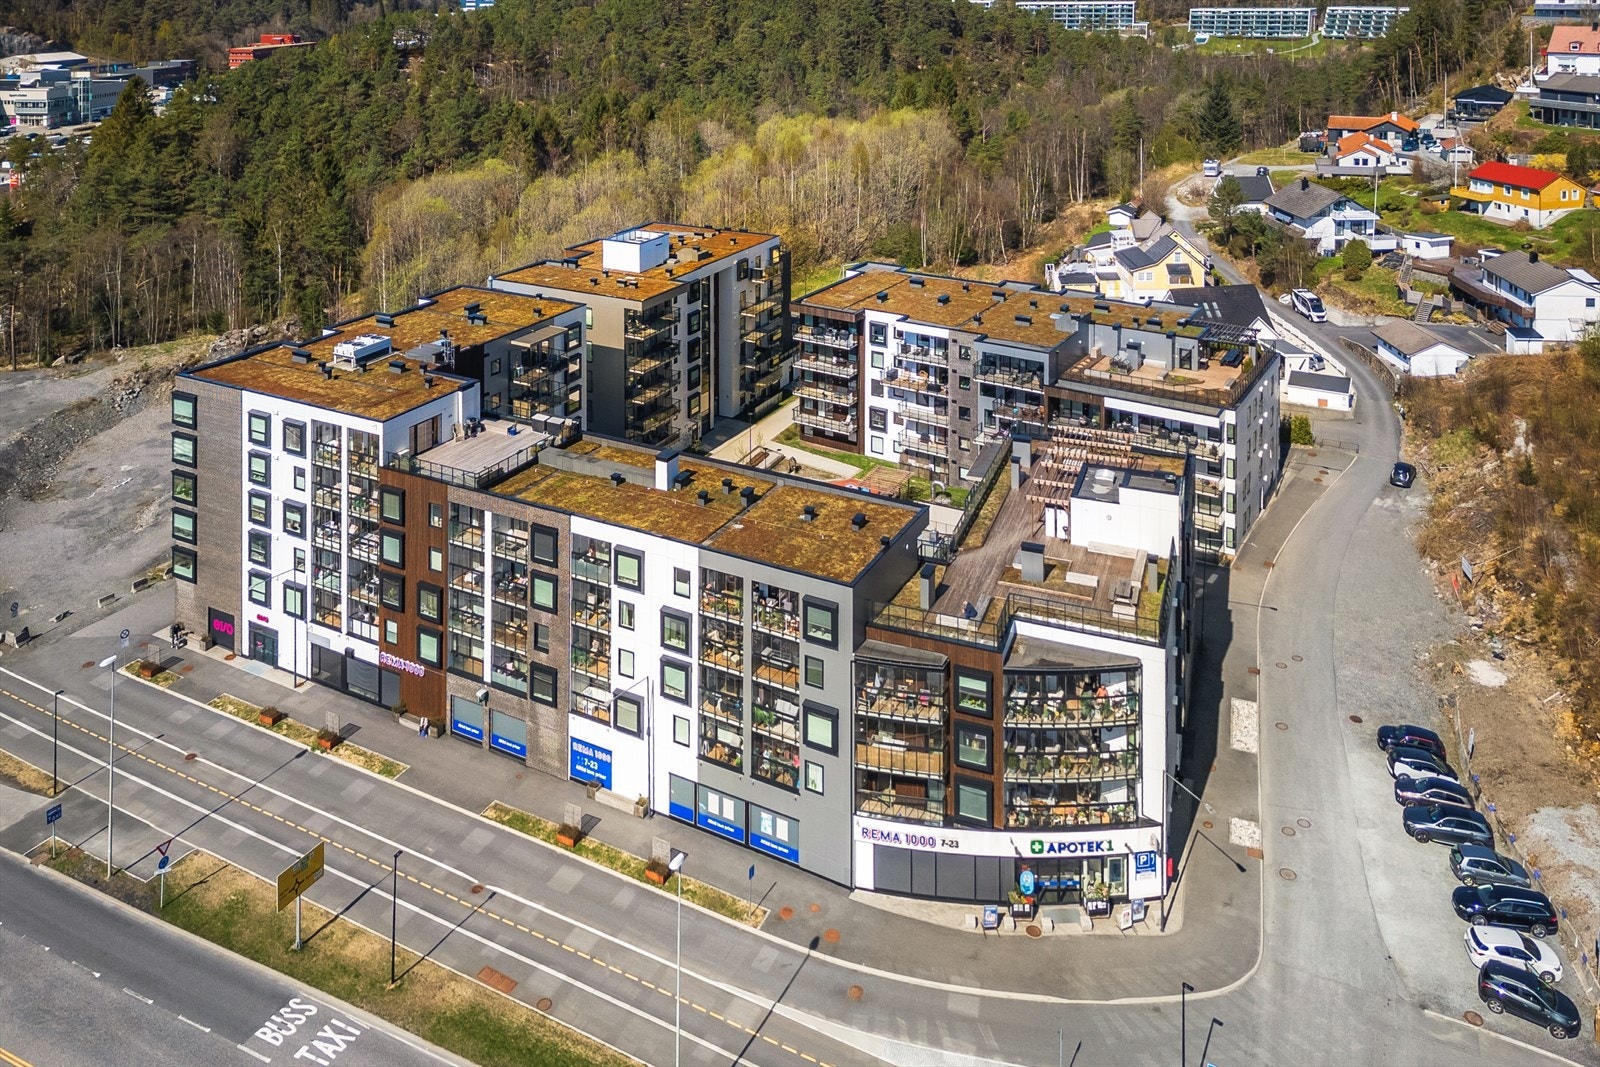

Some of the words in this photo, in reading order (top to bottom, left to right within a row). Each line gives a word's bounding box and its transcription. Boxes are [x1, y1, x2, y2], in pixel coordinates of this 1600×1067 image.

[213, 619, 234, 635] evo
[380, 651, 404, 670] REMA
[404, 660, 425, 677] 1000
[572, 742, 594, 757] REMA
[594, 749, 611, 763] 1000
[584, 758, 598, 770] 7-23
[862, 827, 901, 844] REMA
[905, 834, 936, 848] 1000
[940, 839, 959, 848] 7-23
[1139, 855, 1147, 865] P
[254, 998, 318, 1047] BUSS
[293, 1018, 361, 1066] TAXI
